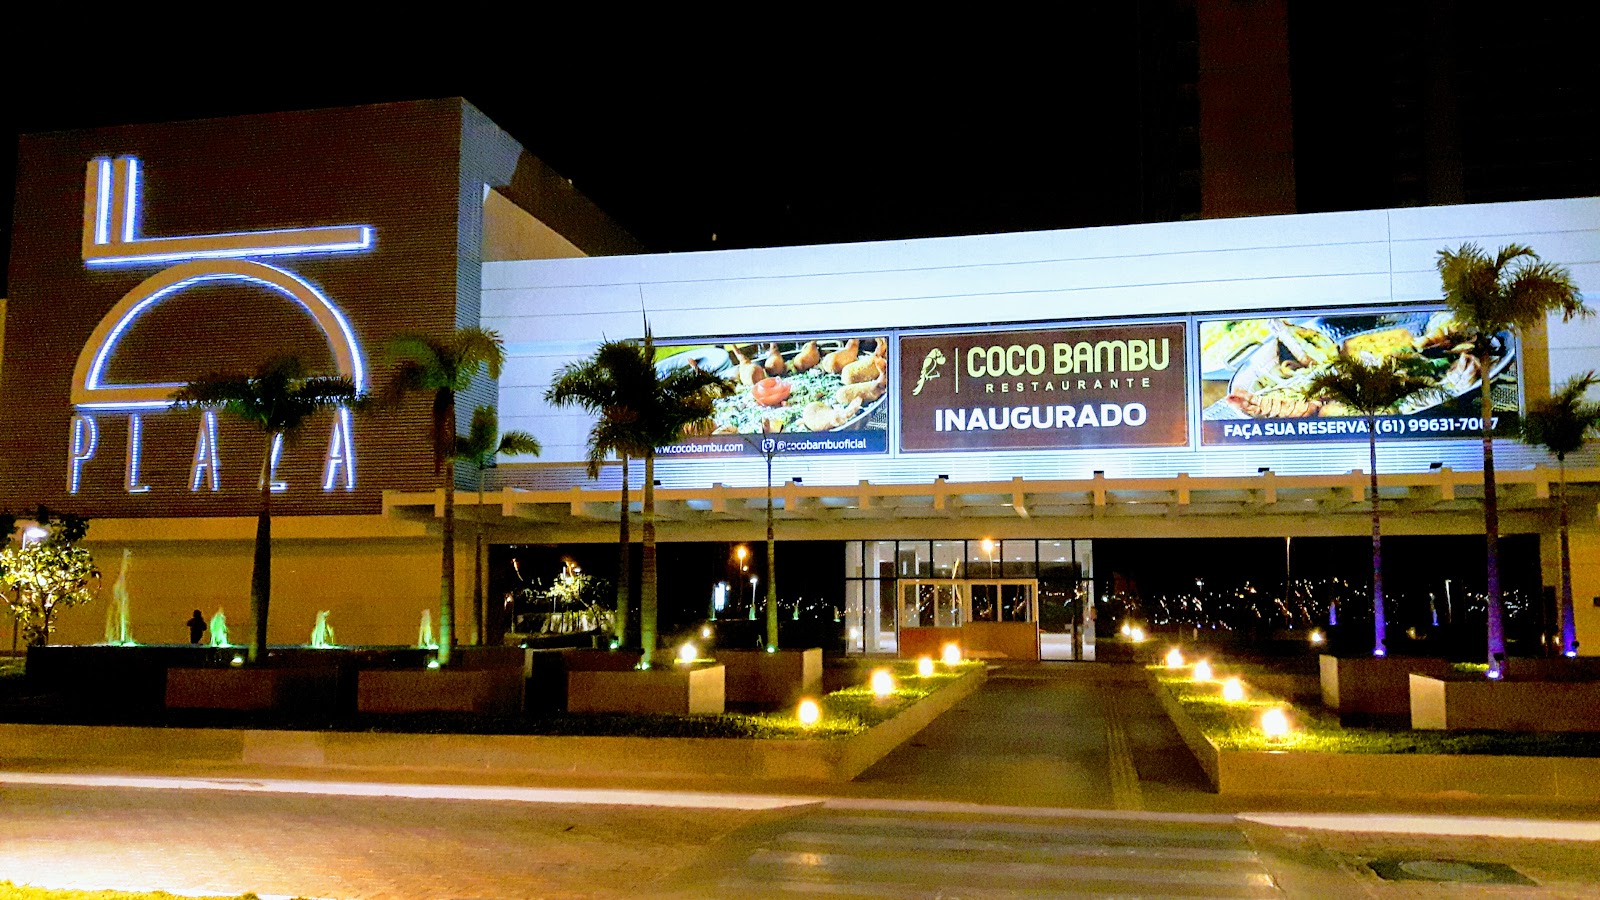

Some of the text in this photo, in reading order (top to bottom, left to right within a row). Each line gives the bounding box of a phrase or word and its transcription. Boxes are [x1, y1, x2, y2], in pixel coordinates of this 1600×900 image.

[967, 338, 1169, 378] COCO BAMBU
[986, 377, 1150, 393] RESTAURANTE
[935, 403, 1147, 432] INAUGURADO
[1224, 424, 1262, 440] FAÇA
[1264, 423, 1295, 436] SUA
[1375, 419, 1405, 434] (61)
